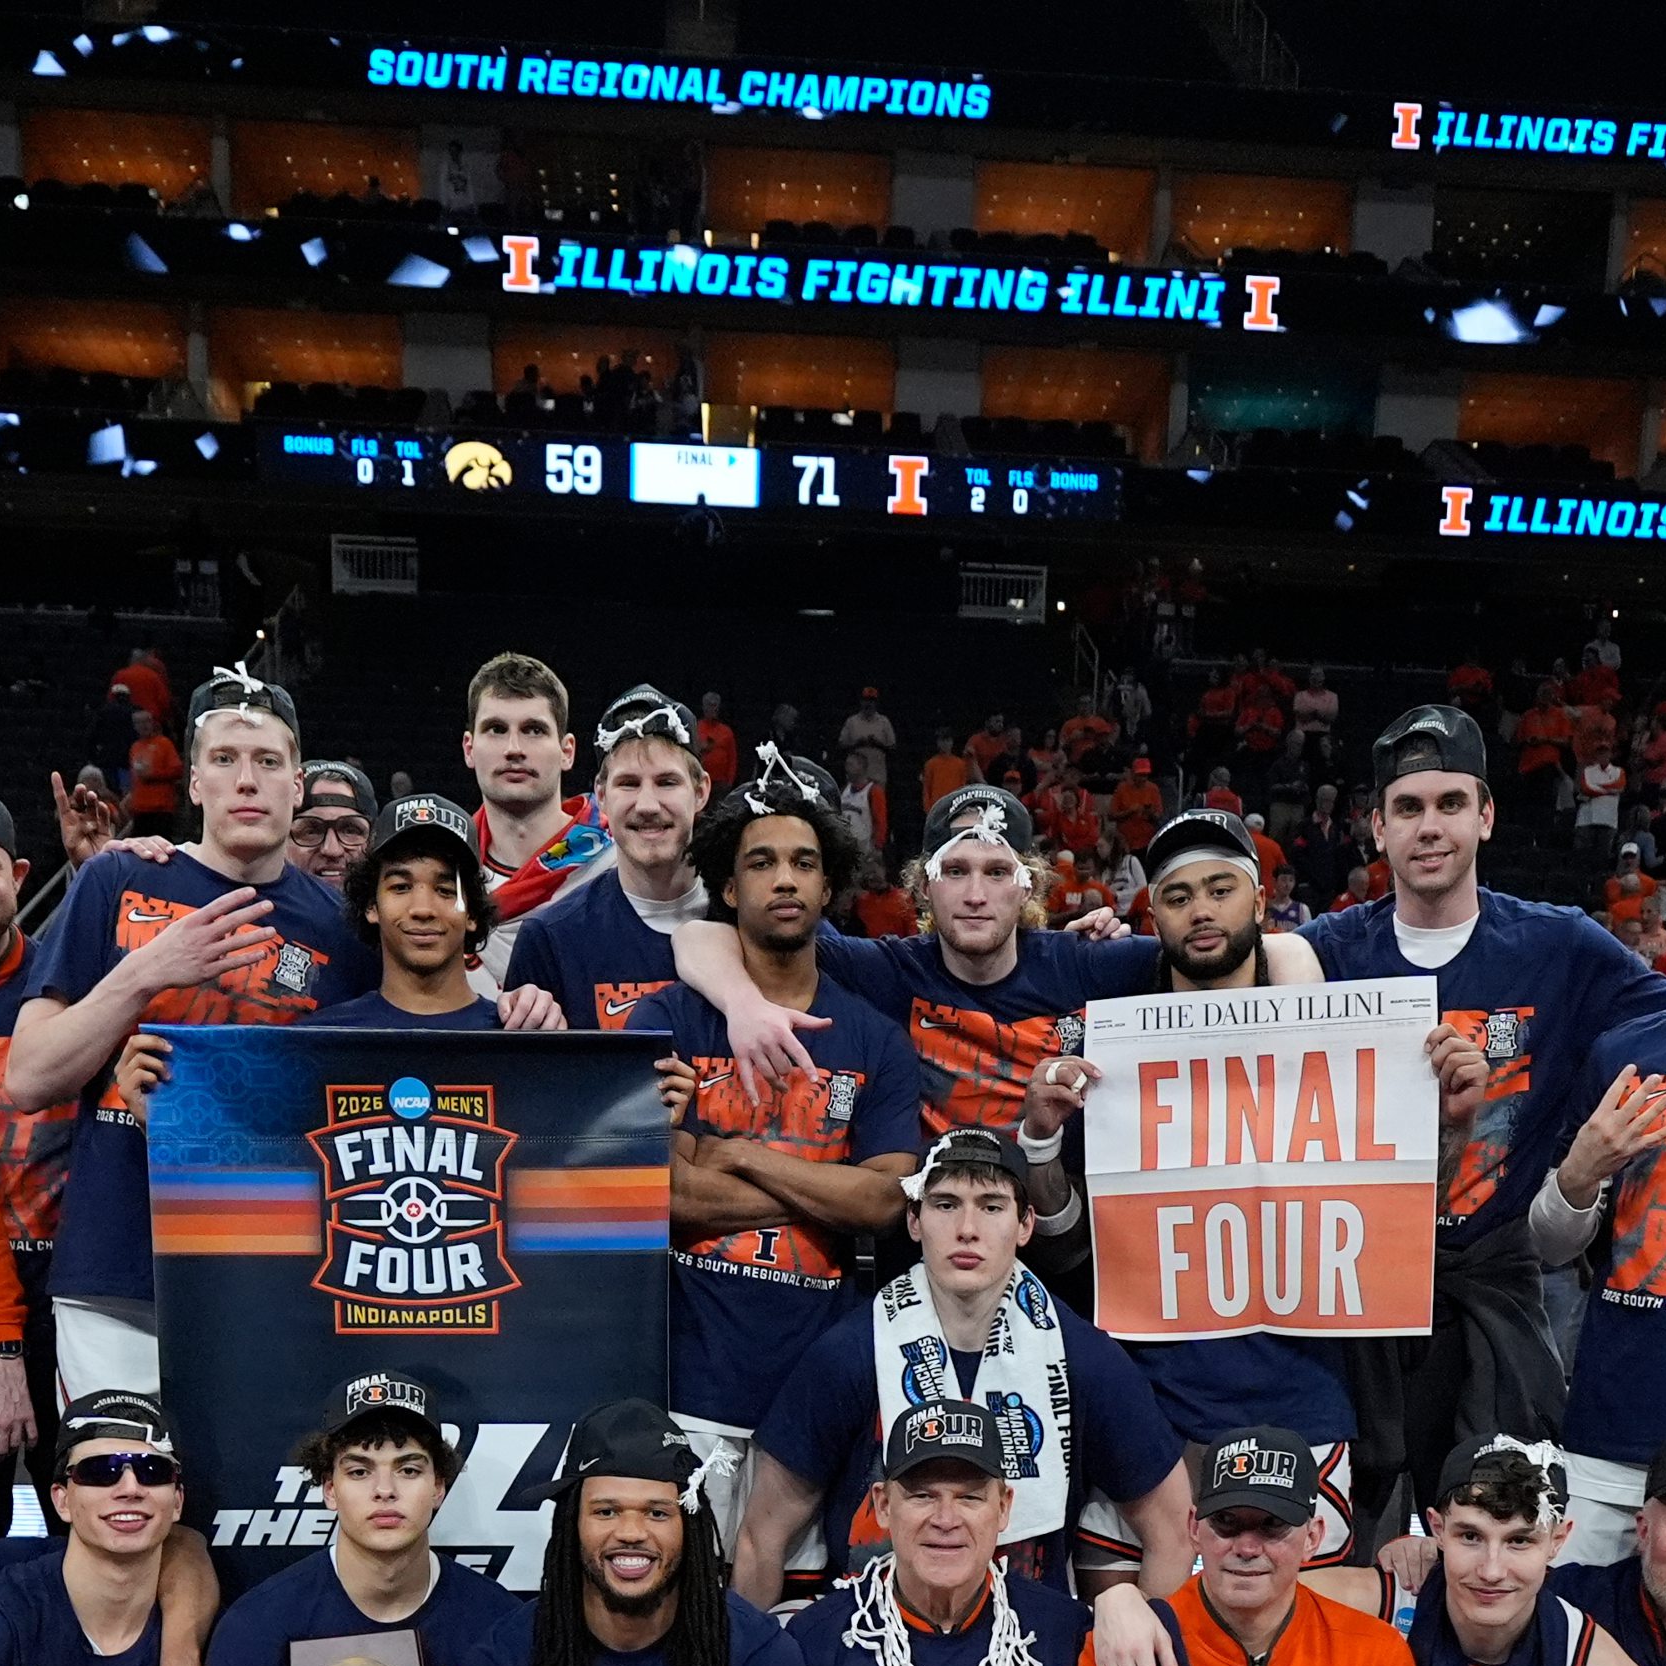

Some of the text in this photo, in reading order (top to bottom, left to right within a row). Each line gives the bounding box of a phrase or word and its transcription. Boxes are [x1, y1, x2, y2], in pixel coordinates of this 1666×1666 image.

[367, 48, 991, 119] SOUTH REGIONAL CHAMPIONS
[1432, 110, 1617, 155] ILLINOIS
[551, 243, 789, 300] ILLINOIS
[801, 258, 1049, 312] FIGHTING
[1057, 272, 1227, 322] ILLINI
[283, 435, 422, 459] BONUS FLS TOL
[678, 451, 713, 465] FINAL
[356, 458, 416, 486] 0 1
[545, 443, 602, 495] 59
[792, 455, 840, 506] 71
[965, 468, 1098, 491] TOL FLS BONUS
[971, 488, 1028, 514] 2 0
[395, 799, 436, 814] FINAL
[1136, 990, 1386, 1031] THE DAILY ILLINI
[336, 1094, 485, 1118] 2026 NCAA MEN'S
[1137, 1047, 1397, 1172] FINAL
[333, 1124, 484, 1183] FINAL
[343, 1240, 485, 1296] FOUR
[696, 1257, 740, 1278] SOUTH
[742, 1264, 801, 1287] REGIONAL
[1155, 1198, 1366, 1321] FOUR
[1603, 1288, 1621, 1302] 2026
[1622, 1293, 1663, 1309] SOUTH
[345, 1302, 488, 1327] INDIANAPOLIS
[347, 1373, 389, 1395] FINAL
[905, 1405, 947, 1429] FINAL
[1008, 1407, 1030, 1455] MARCH
[997, 1415, 1021, 1480] MADNESS
[1217, 1438, 1258, 1461] FINAL
